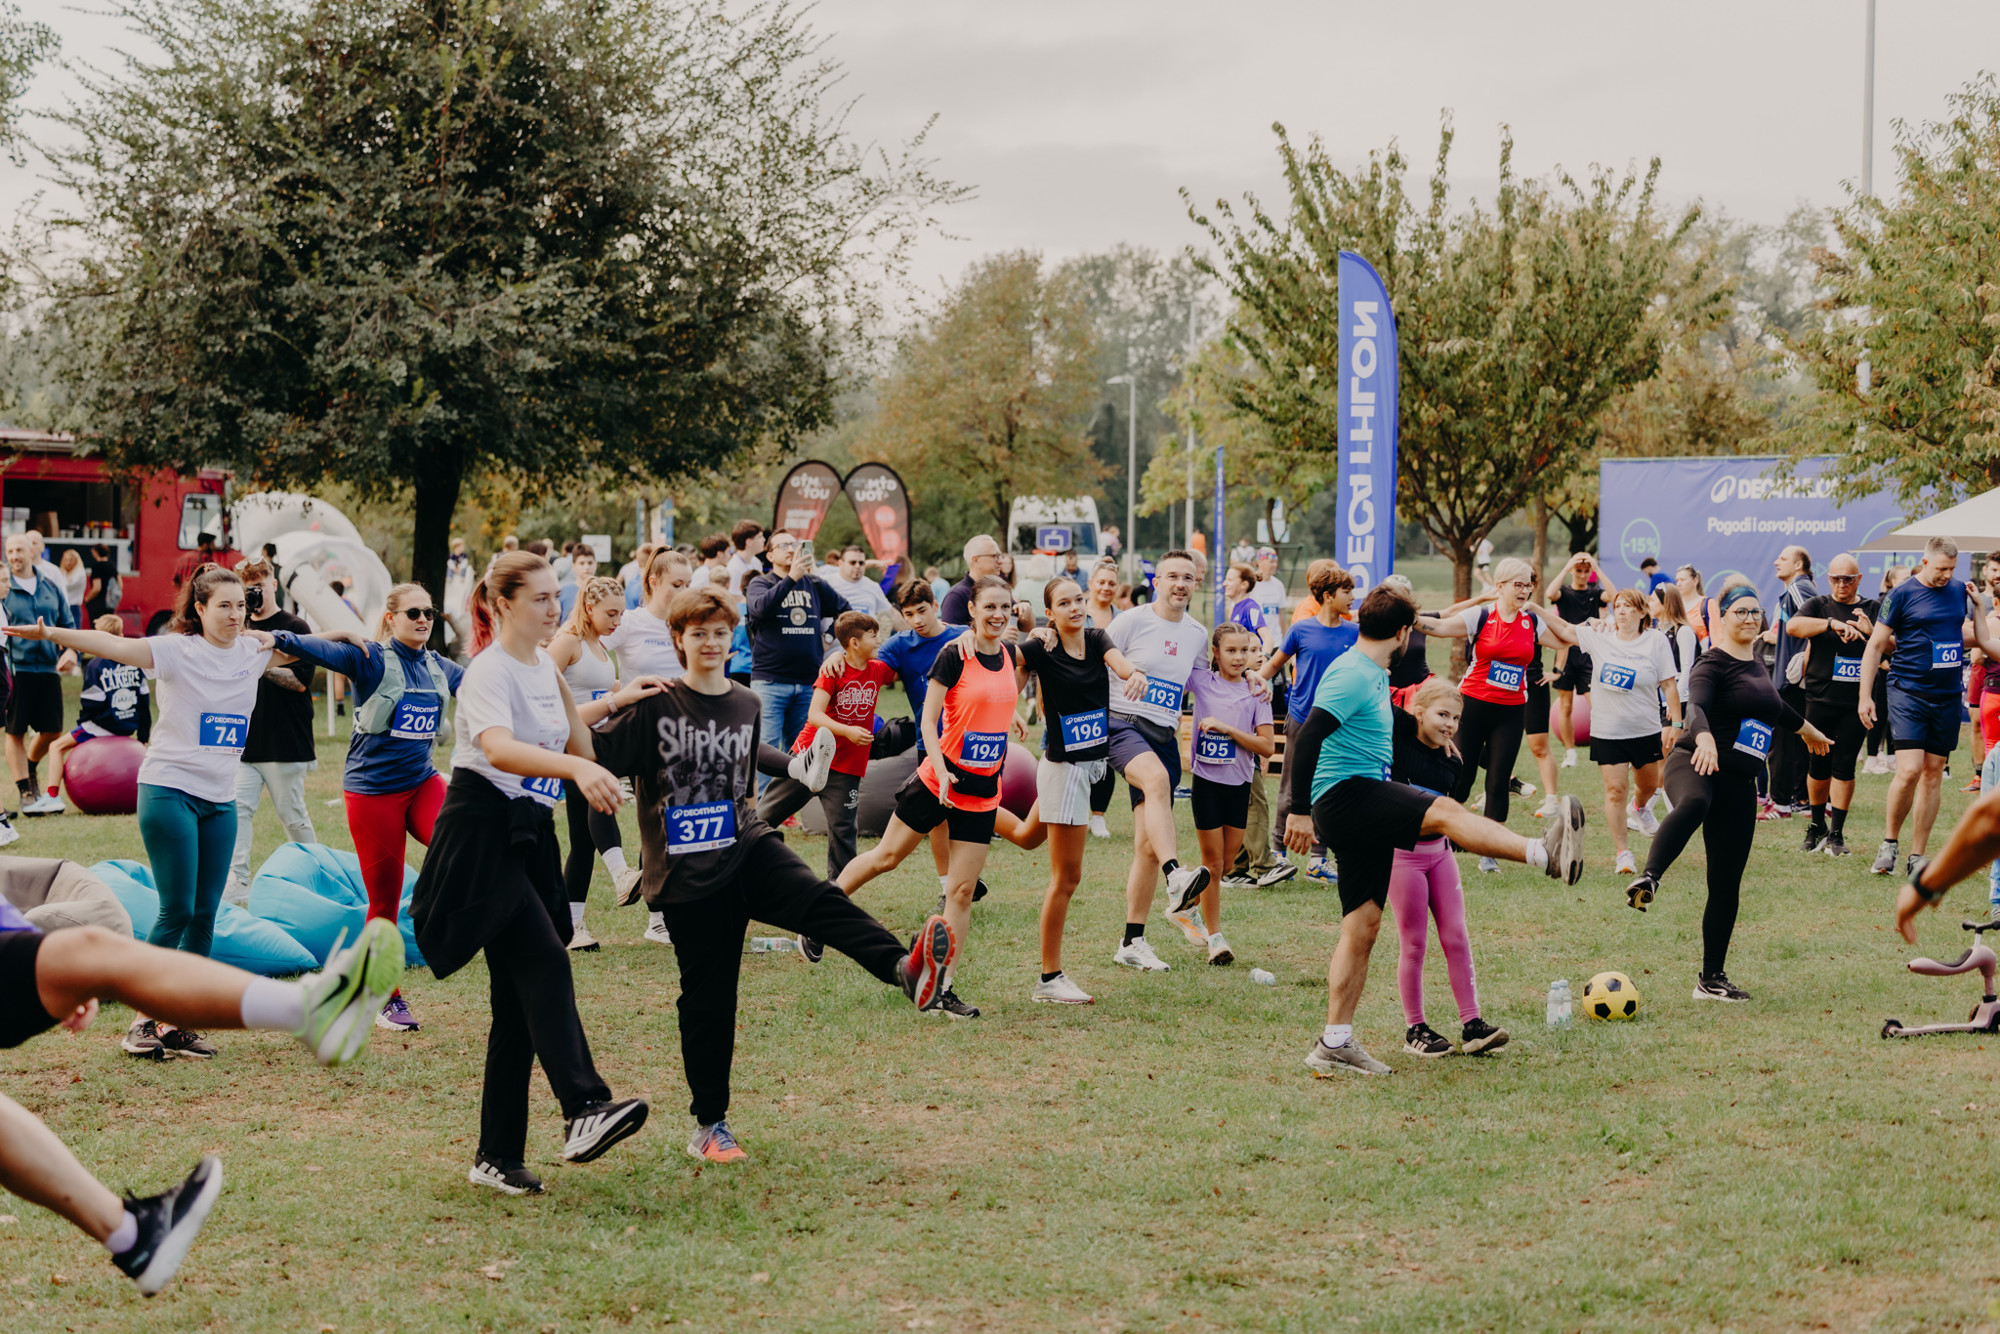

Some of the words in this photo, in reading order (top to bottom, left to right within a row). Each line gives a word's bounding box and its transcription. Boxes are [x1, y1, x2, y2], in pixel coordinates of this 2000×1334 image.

[1707, 516, 1752, 537] Pogodi
[1752, 516, 1758, 533] i
[1758, 516, 1795, 536] osvoji
[1795, 516, 1847, 536] popust!
[1624, 537, 1657, 554] -15%
[1942, 649, 1957, 662] 60
[1494, 669, 1519, 685] 108
[1603, 671, 1630, 687] 297
[1837, 664, 1862, 677] 403
[1149, 687, 1176, 708] 193
[400, 713, 435, 732] 206
[215, 726, 238, 745] 74
[1071, 721, 1102, 742] 196
[1200, 740, 1229, 757] 195
[1751, 732, 1765, 750] 13
[970, 743, 1000, 760] 194
[531, 777, 560, 797] 278
[683, 805, 728, 817] DECATHLON
[679, 816, 724, 842] 377
